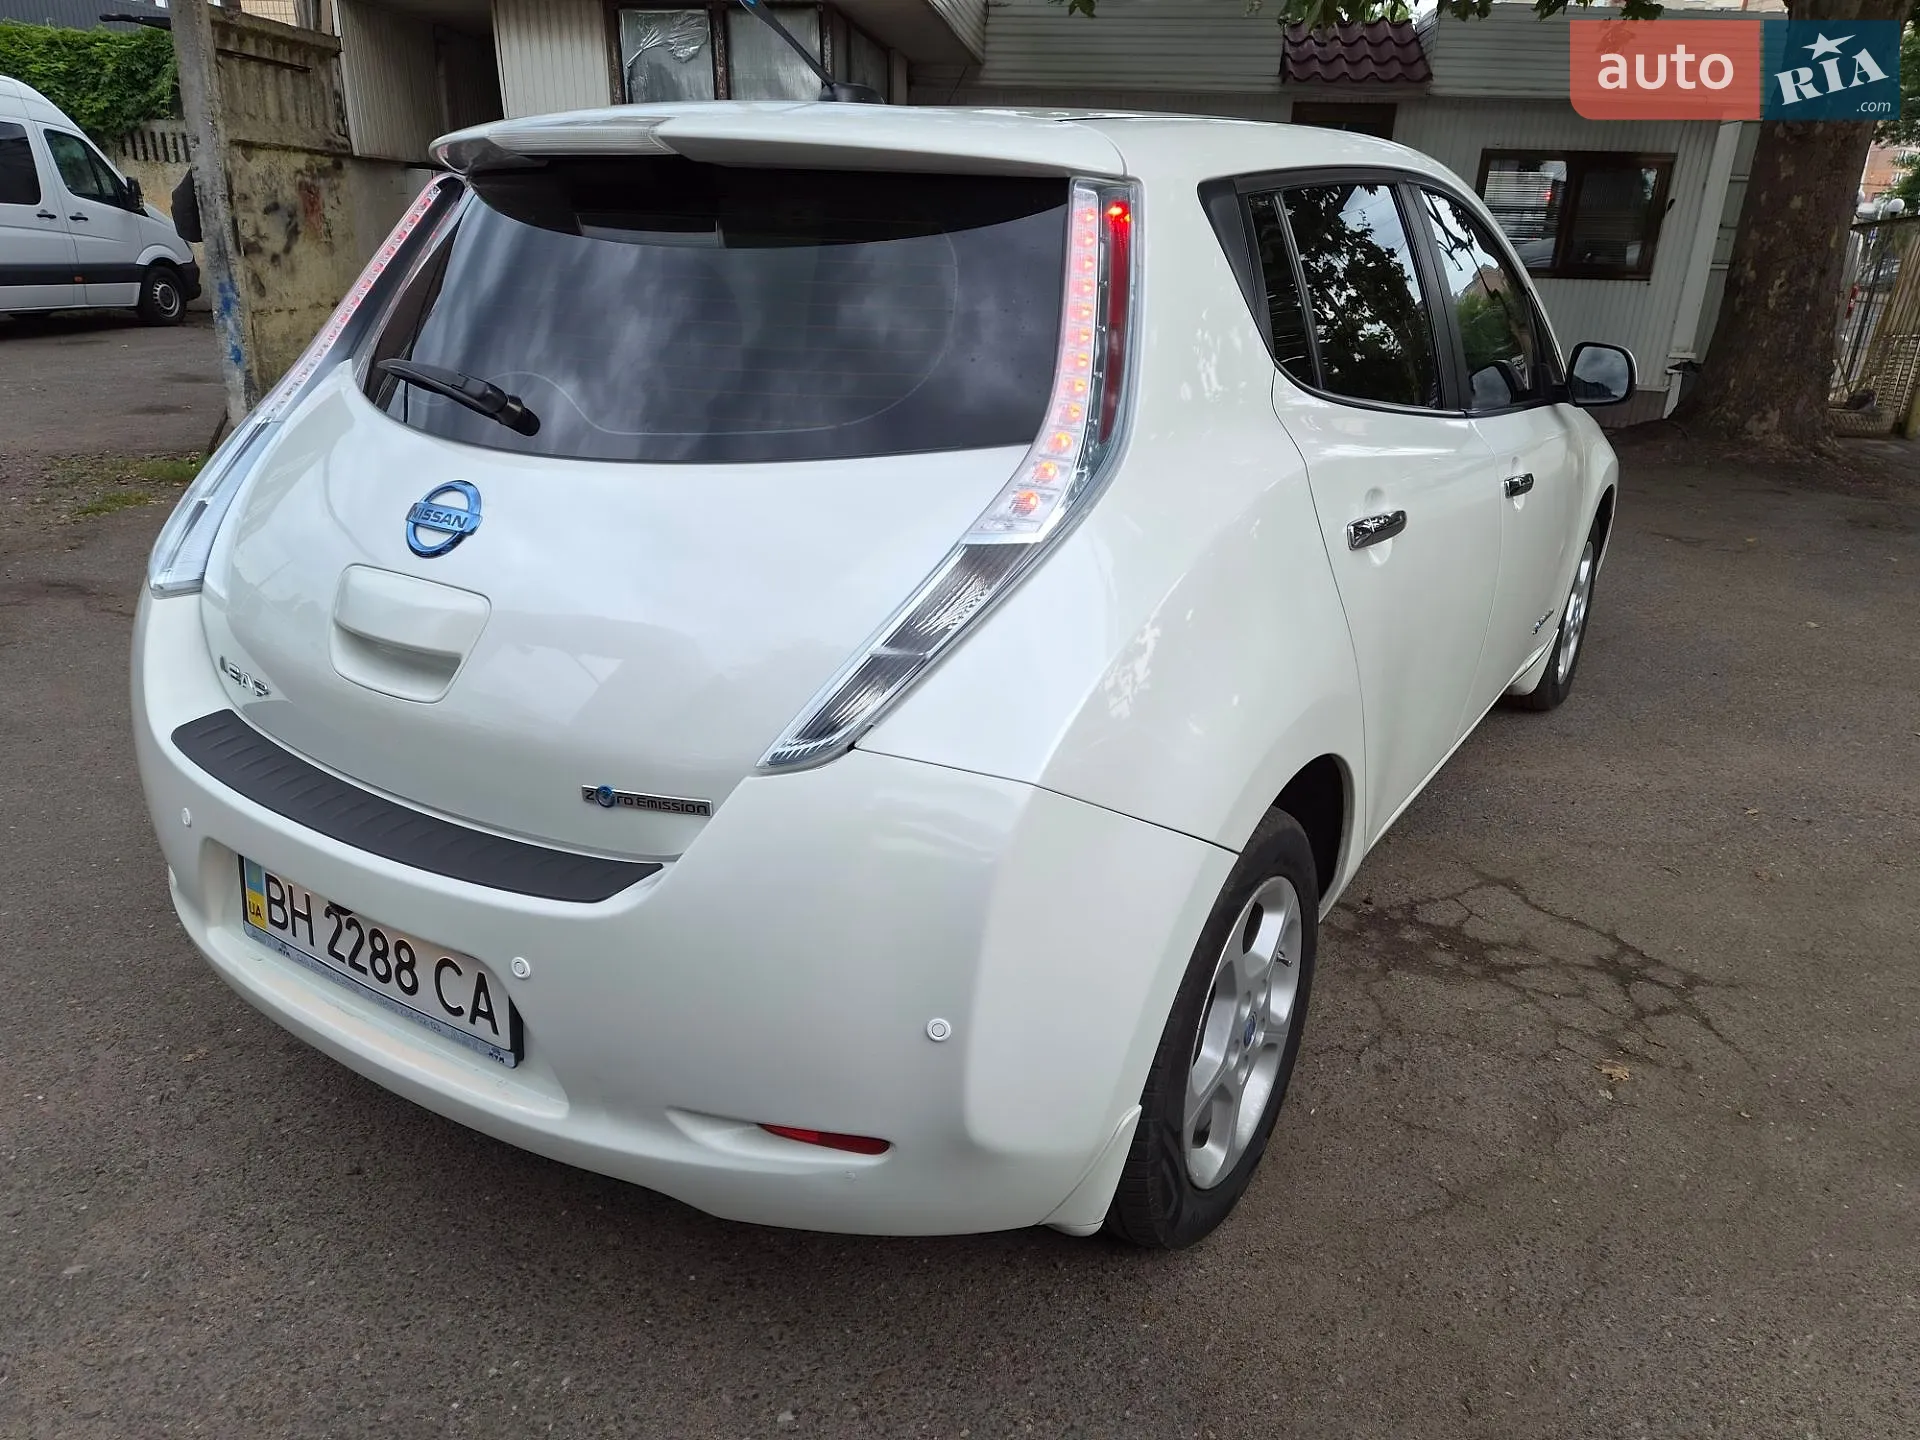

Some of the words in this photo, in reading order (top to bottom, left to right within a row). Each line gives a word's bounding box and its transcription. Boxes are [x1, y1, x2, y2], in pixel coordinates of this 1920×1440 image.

[410, 506, 468, 529] NISSAN
[248, 900, 263, 920] UA
[264, 872, 315, 947] BH
[323, 904, 420, 996] 2288
[434, 956, 500, 1036] CA
